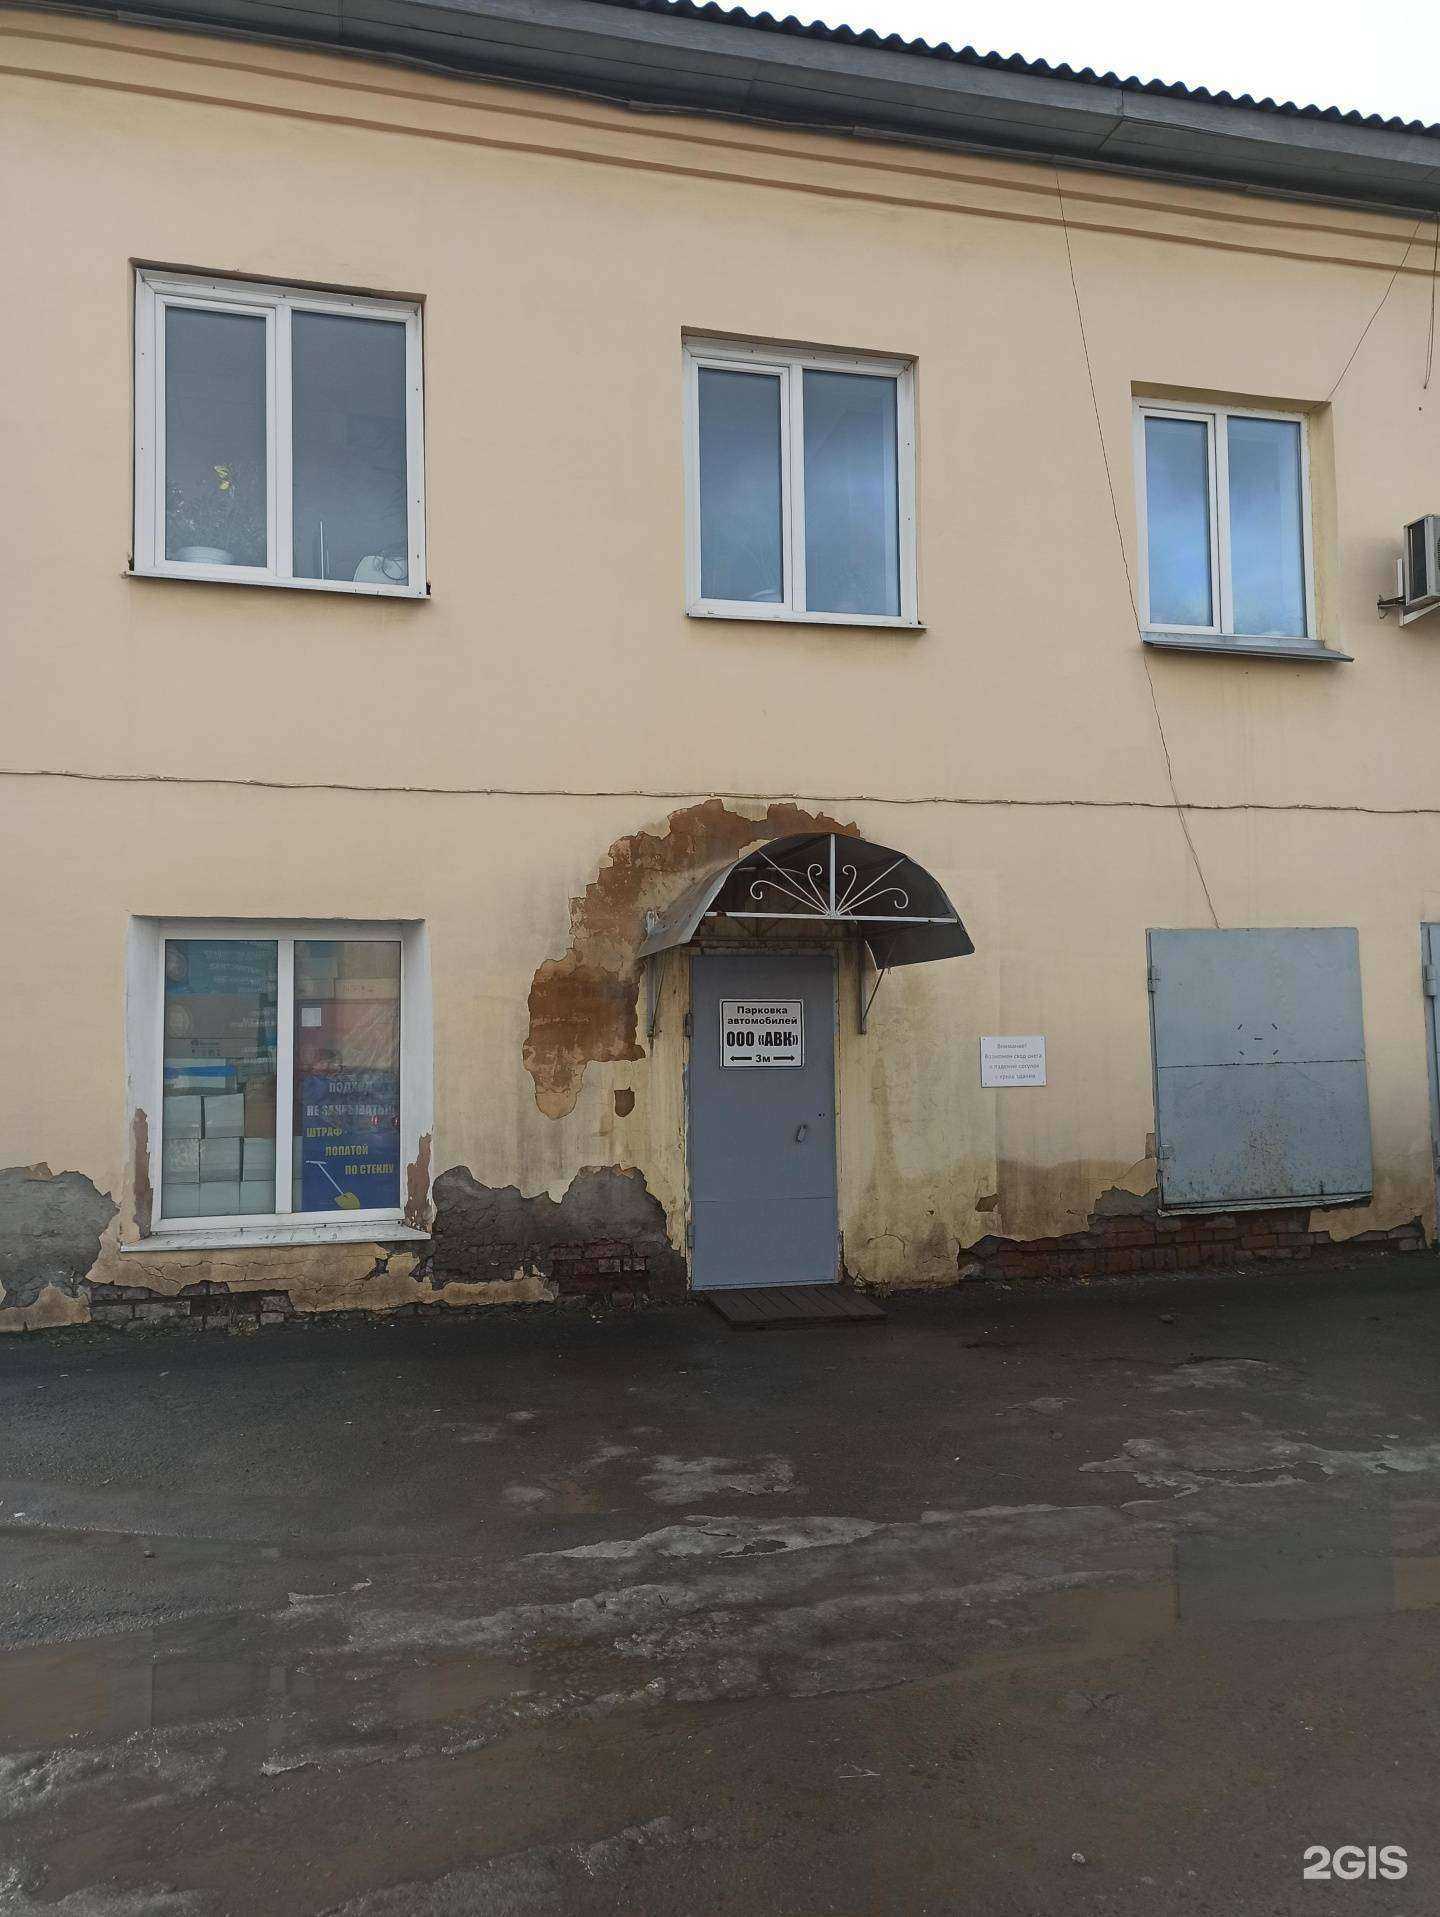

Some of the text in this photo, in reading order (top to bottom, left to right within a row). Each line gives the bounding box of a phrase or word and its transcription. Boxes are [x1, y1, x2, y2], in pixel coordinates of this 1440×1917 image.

[737, 1006, 788, 1016] Парковка
[727, 1016, 798, 1026] автомобилей
[726, 1031, 799, 1047] ООО «АВК»
[755, 1054, 771, 1063] 3м
[306, 1105, 319, 1117] НЕ
[325, 1144, 369, 1157] ЛОПАТОЙ
[345, 1163, 394, 1176] ПО СТЕКЛУ
